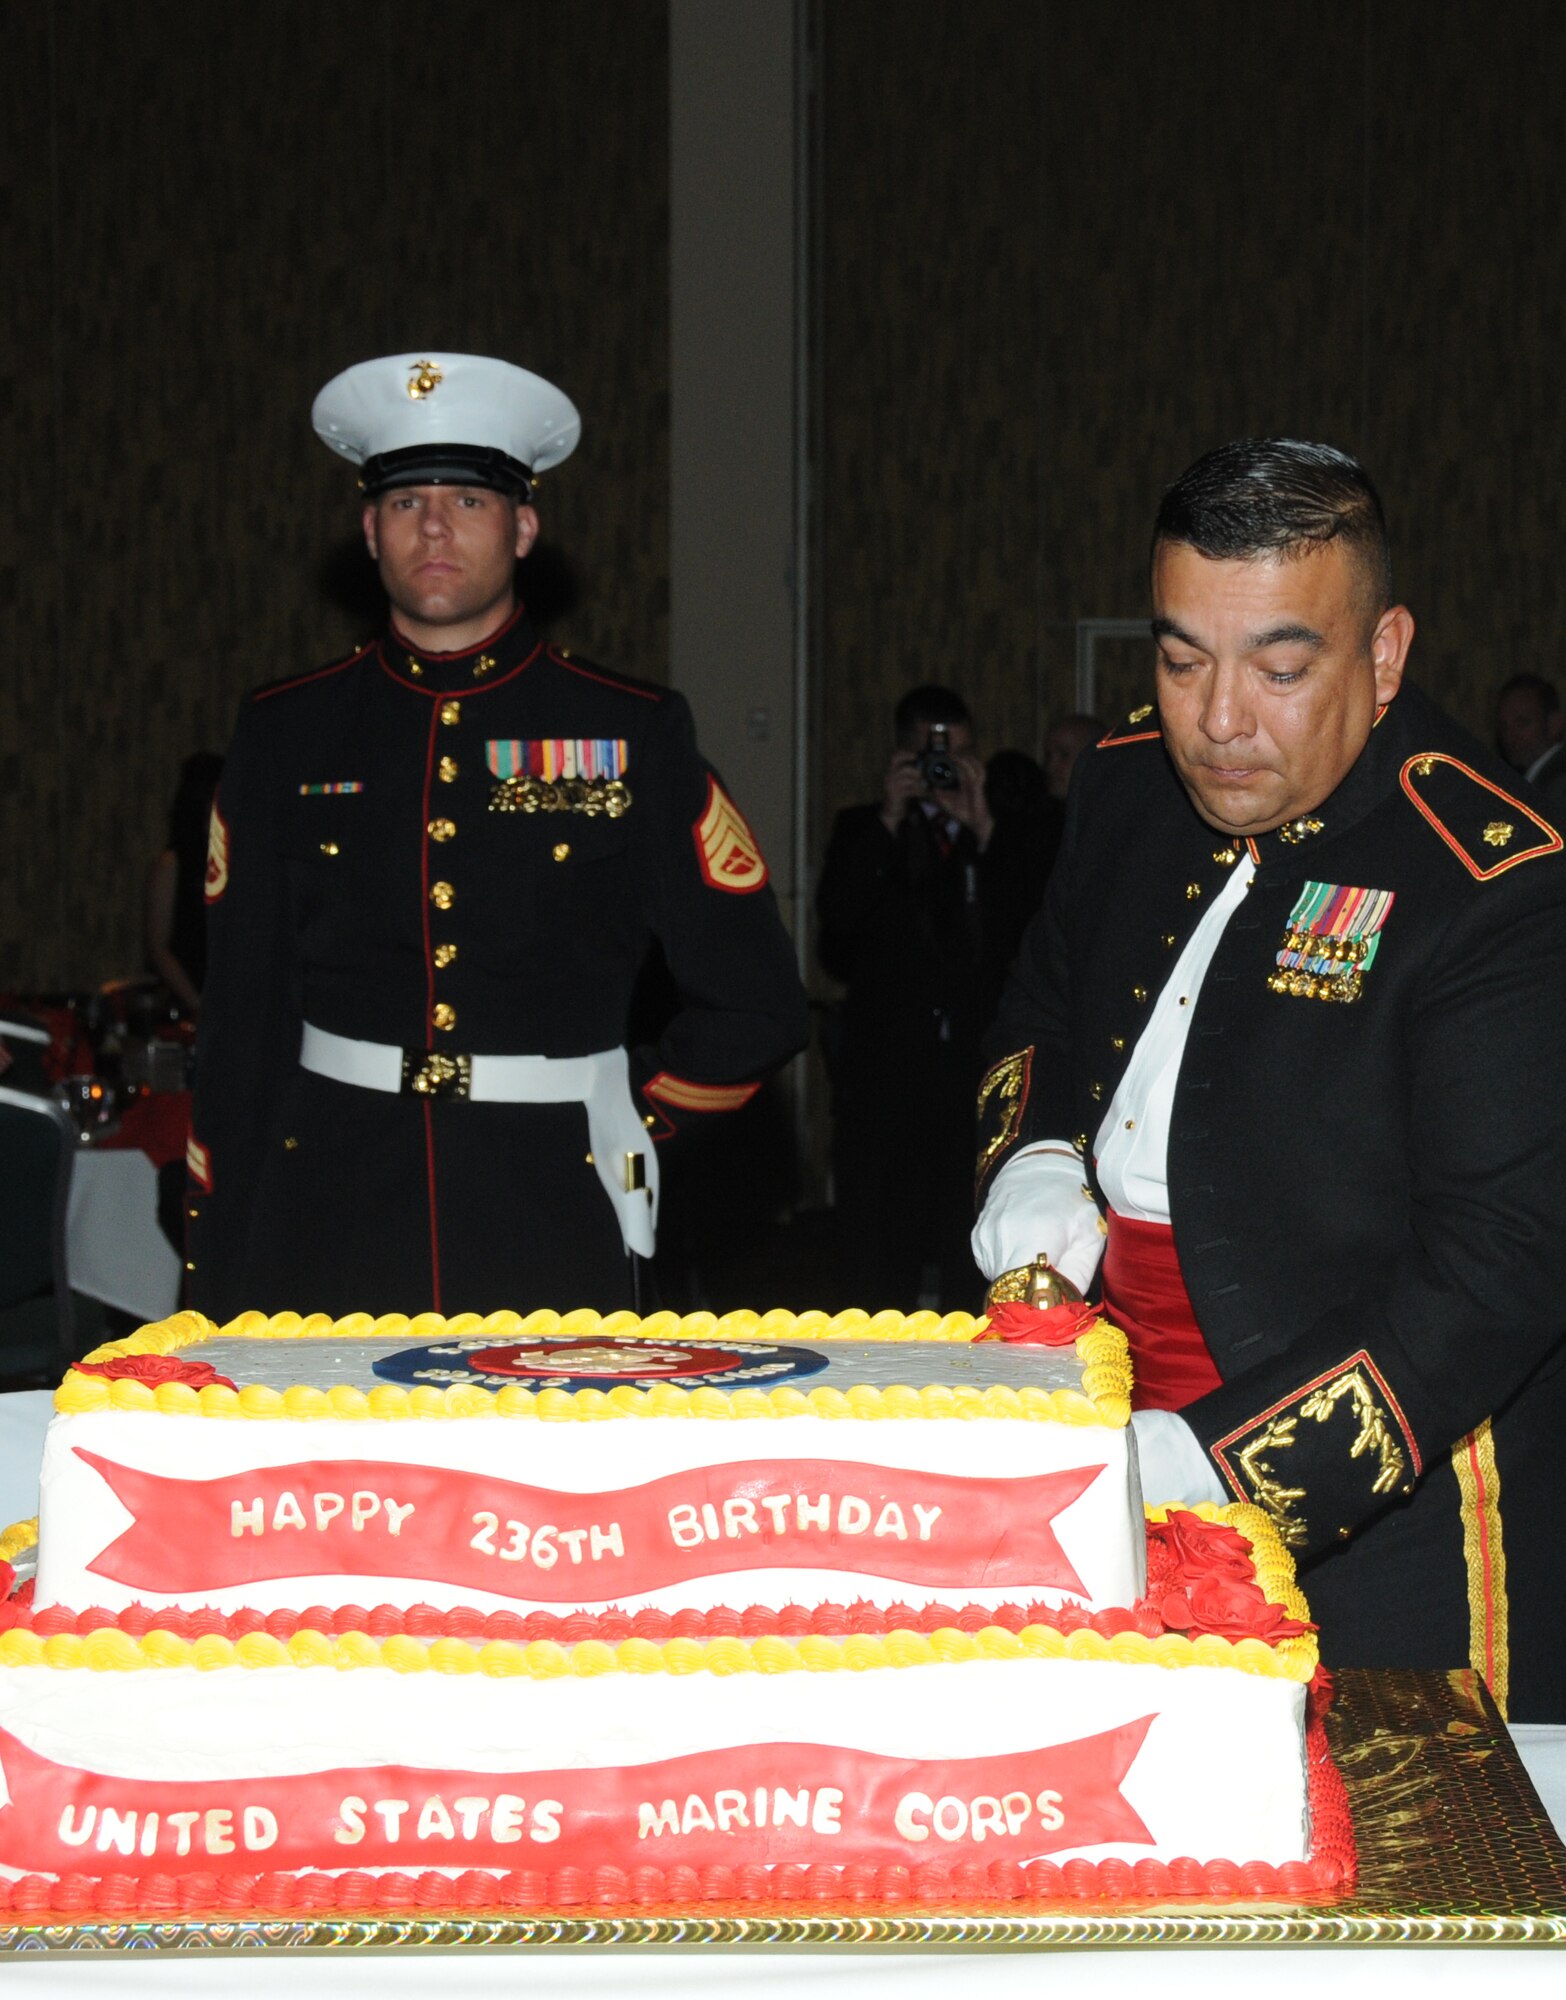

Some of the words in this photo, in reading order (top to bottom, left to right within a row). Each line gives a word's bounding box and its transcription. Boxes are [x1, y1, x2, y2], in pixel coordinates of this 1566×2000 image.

[231, 1491, 415, 1536] HAPPY
[469, 1513, 625, 1569] 236TH
[668, 1494, 942, 1548] BIRTHDAY
[58, 1805, 279, 1855] UNITED
[335, 1796, 564, 1844] STATES
[638, 1787, 844, 1839] MARINE
[894, 1790, 1065, 1842] CORPS
